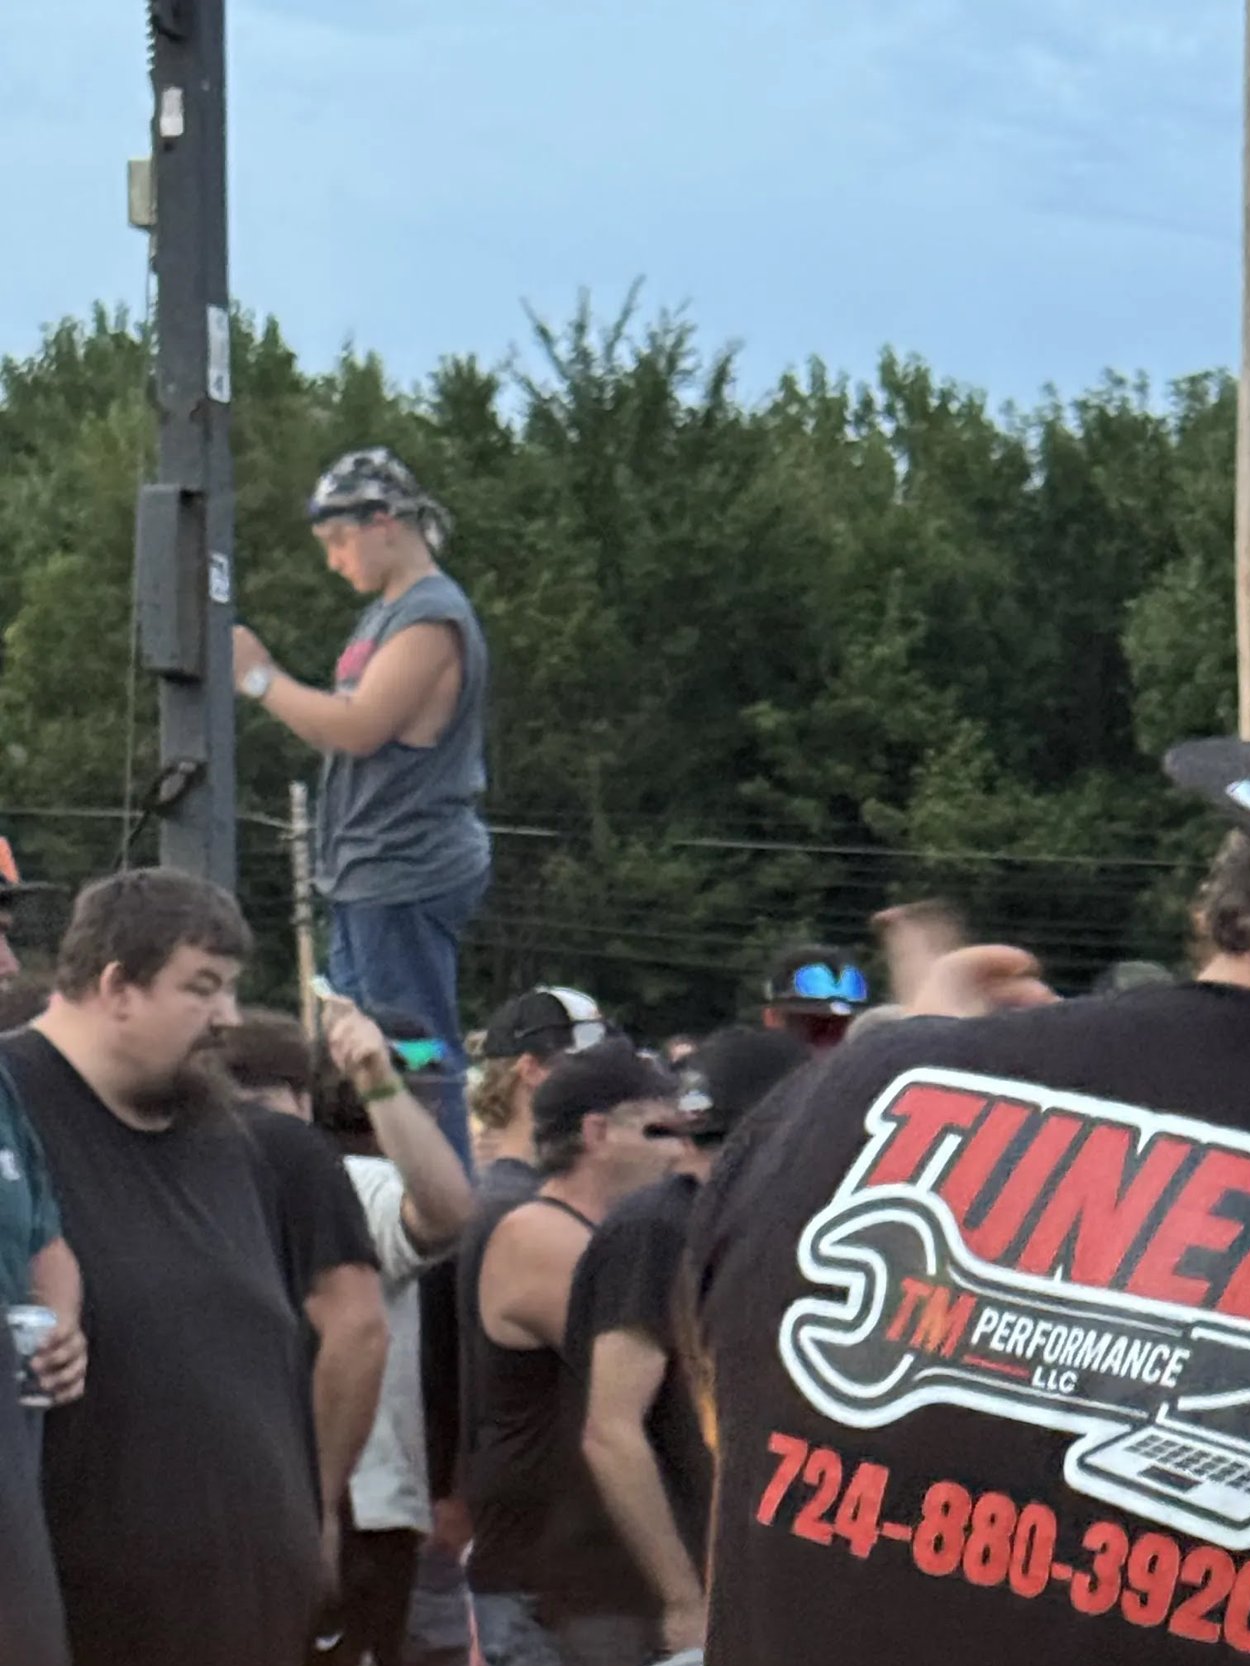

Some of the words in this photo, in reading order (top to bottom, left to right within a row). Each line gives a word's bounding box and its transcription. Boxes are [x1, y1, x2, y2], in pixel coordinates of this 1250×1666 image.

[886, 1277, 978, 1358] TM
[970, 1306, 1192, 1389] PERFORMANCE
[1031, 1365, 1079, 1394] LLC
